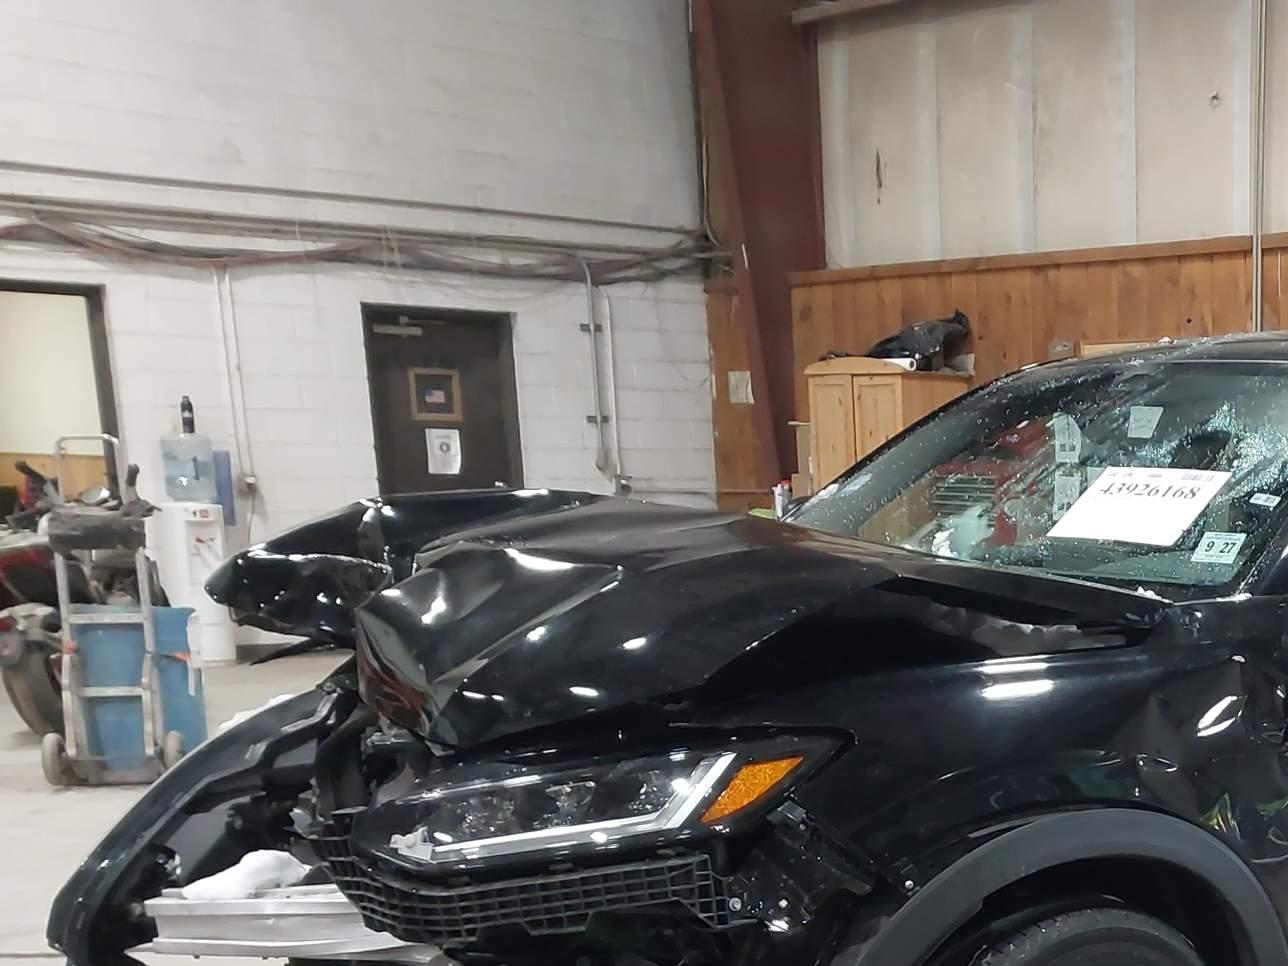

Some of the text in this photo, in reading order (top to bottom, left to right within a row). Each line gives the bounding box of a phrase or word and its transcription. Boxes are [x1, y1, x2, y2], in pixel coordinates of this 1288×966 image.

[1100, 482, 1201, 500] 43926168
[1204, 540, 1237, 554] 9 27
